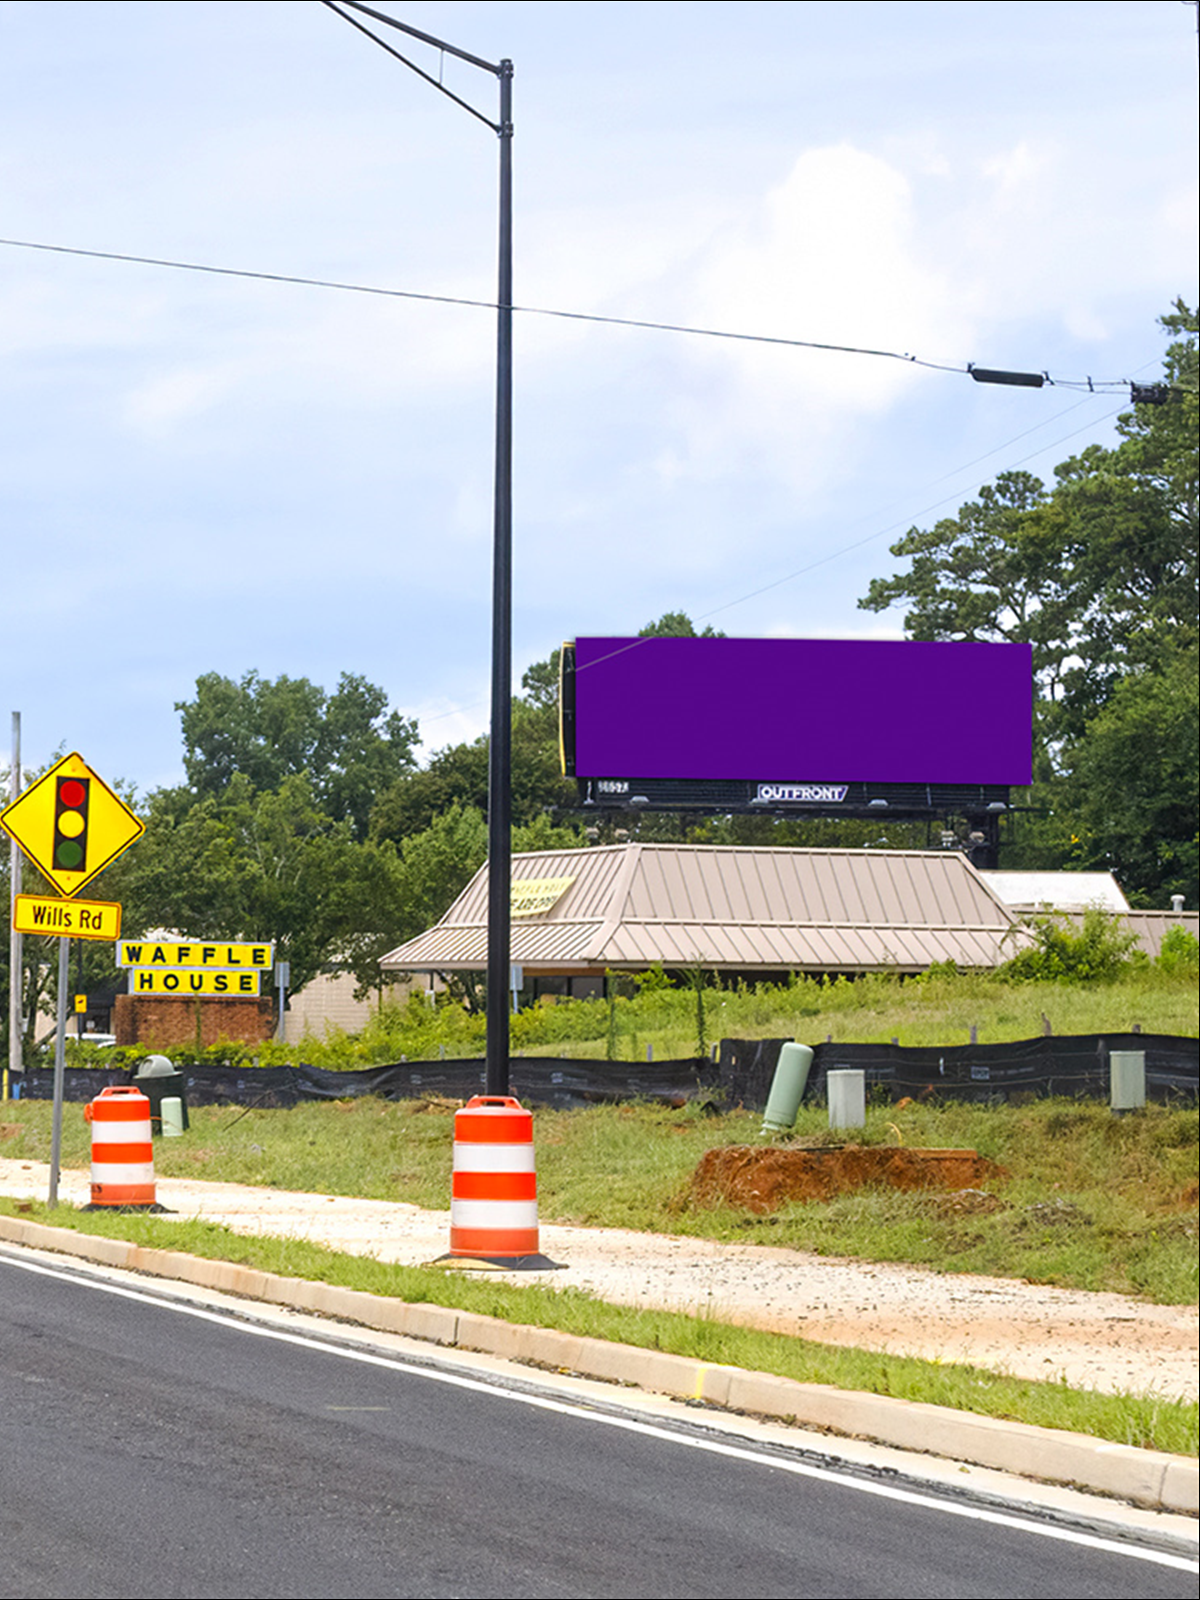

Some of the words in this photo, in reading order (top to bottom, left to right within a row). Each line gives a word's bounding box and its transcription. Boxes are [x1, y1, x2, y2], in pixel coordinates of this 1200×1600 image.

[761, 786, 842, 799] OUTFRONT
[33, 905, 72, 927] Wills
[79, 909, 103, 930] Rd
[125, 945, 266, 964] WAFFLE
[139, 973, 253, 991] HOUSE
